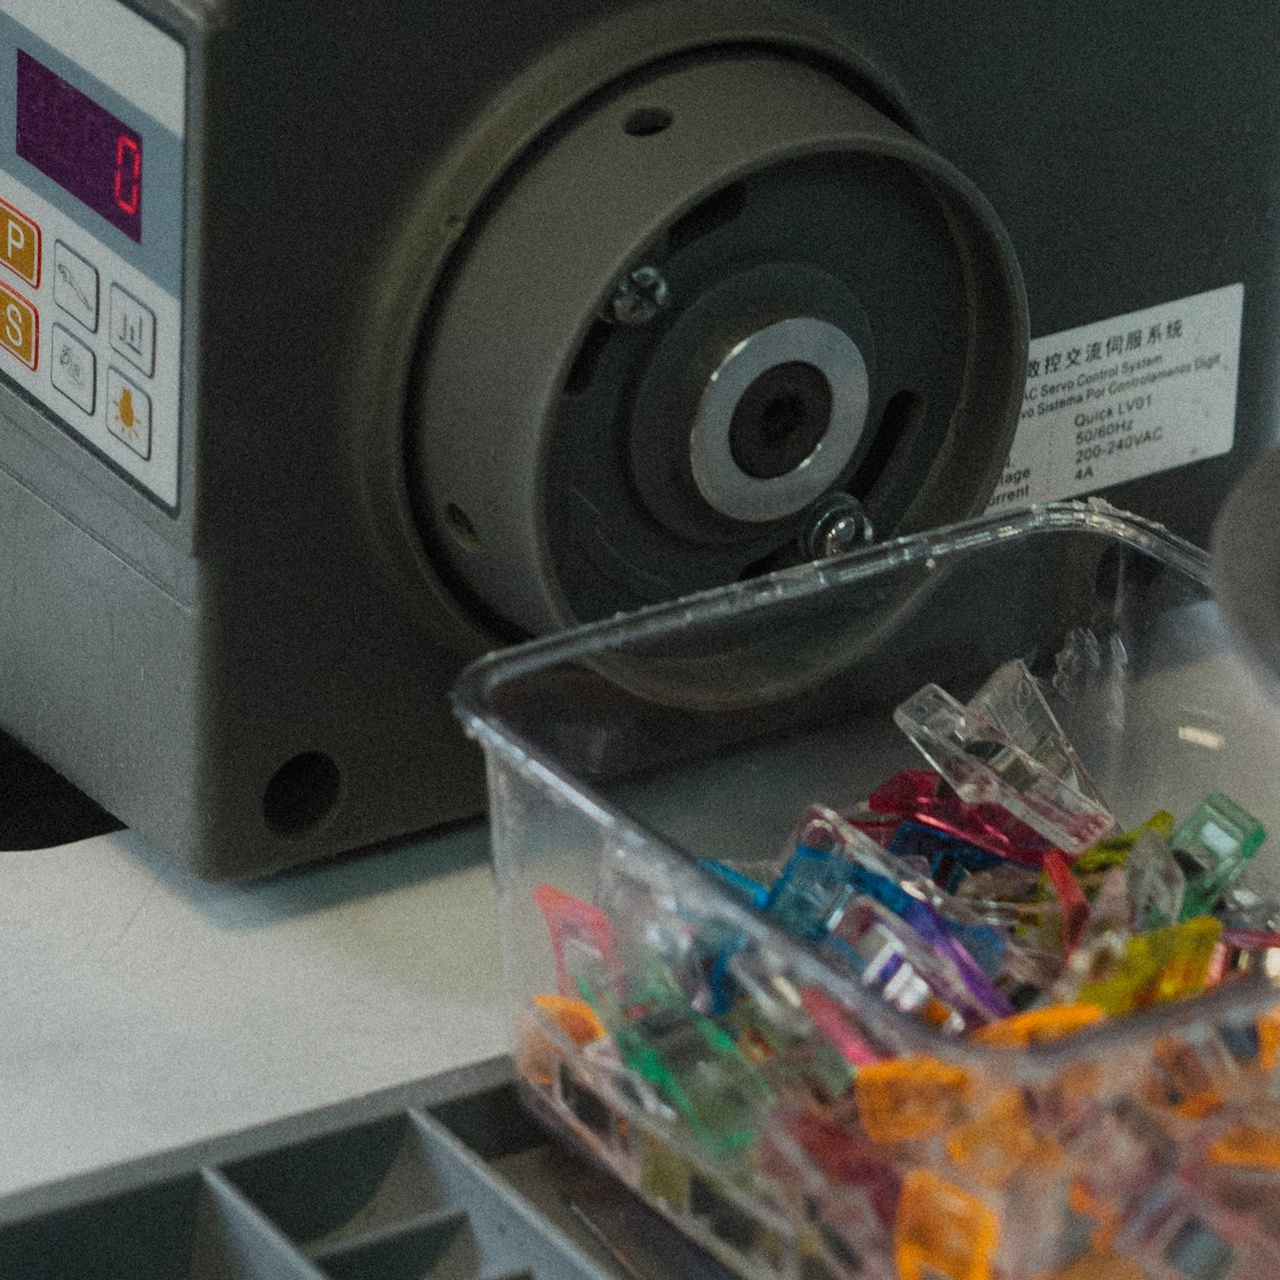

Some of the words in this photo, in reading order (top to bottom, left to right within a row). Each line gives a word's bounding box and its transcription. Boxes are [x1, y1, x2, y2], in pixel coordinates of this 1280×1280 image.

[8, 220, 24, 259] P
[6, 304, 23, 346] S
[1044, 378, 1074, 398] Servo
[1077, 367, 1119, 387] Control
[1037, 392, 1083, 416] Sistema
[1074, 406, 1114, 428] Quick
[1118, 393, 1153, 416] LV01
[1075, 426, 1164, 464] 200-240VAC
[1076, 419, 1134, 445] 50/60Hz
[1075, 466, 1094, 481] 4A
[988, 485, 1029, 506] urrent
